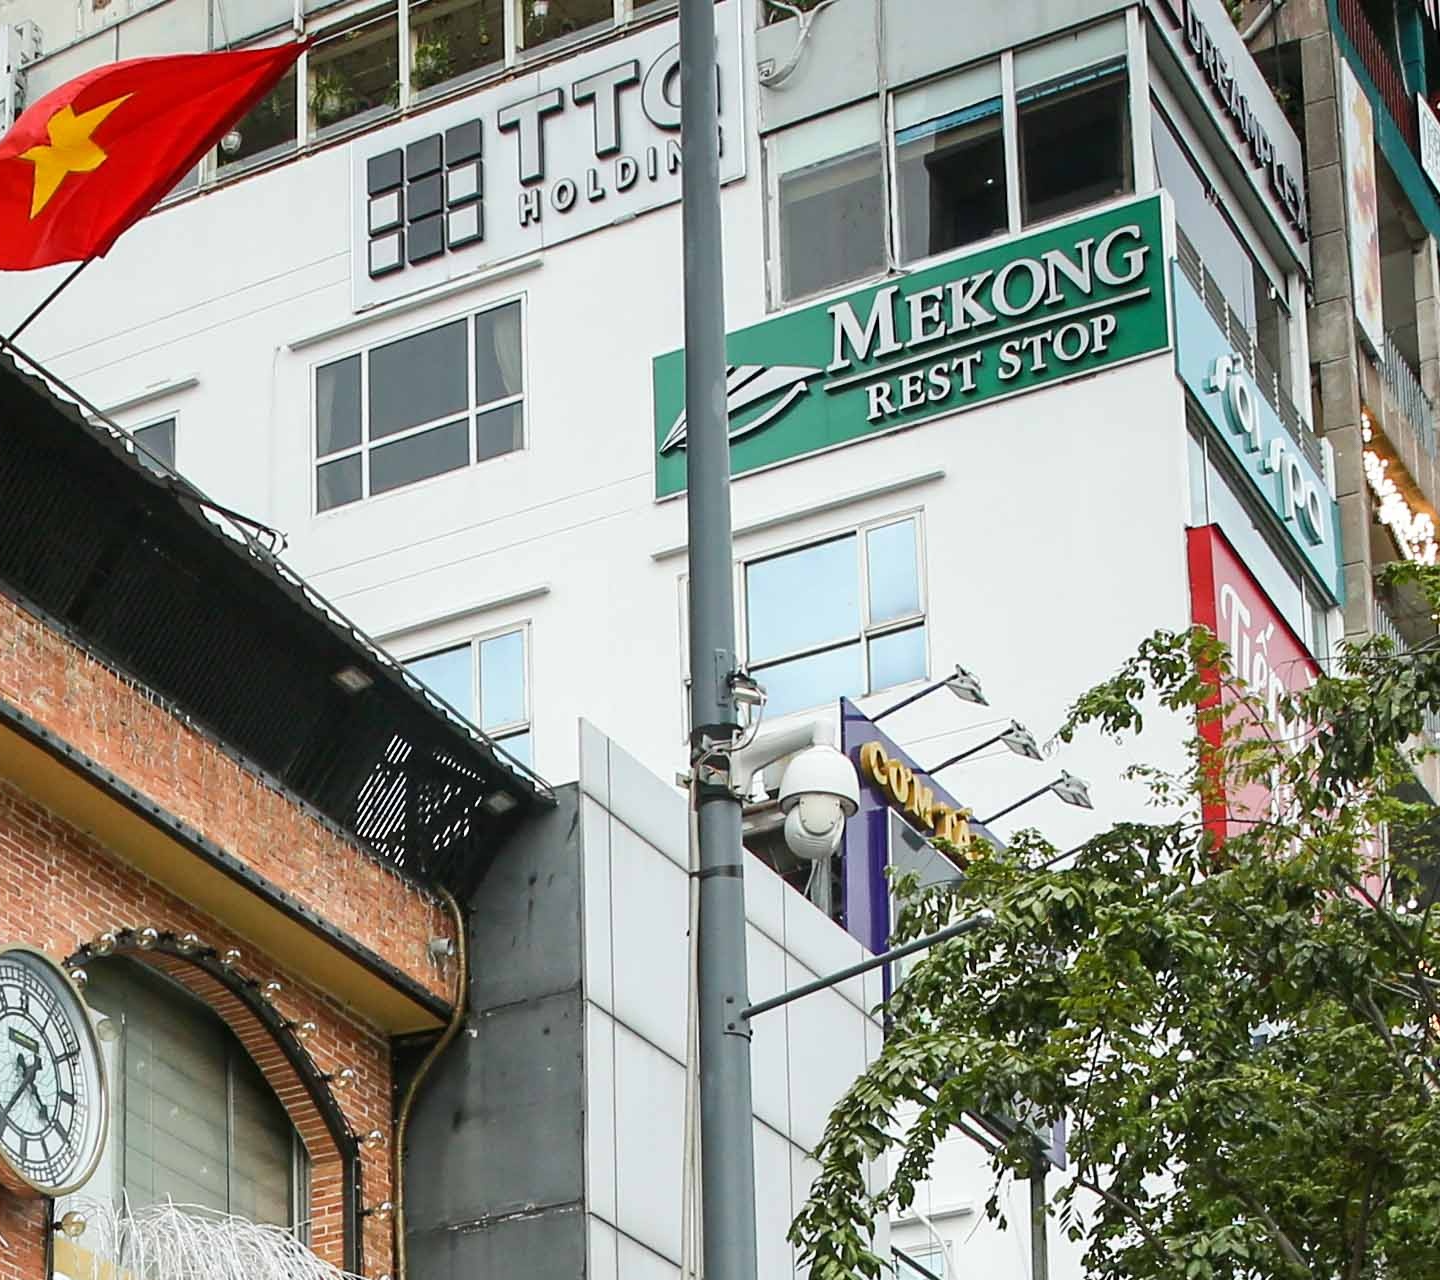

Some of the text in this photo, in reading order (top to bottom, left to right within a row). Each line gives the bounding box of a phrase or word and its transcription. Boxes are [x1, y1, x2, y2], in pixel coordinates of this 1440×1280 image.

[826, 225, 1150, 374] MEKONG
[865, 313, 1116, 422] REST STOP
